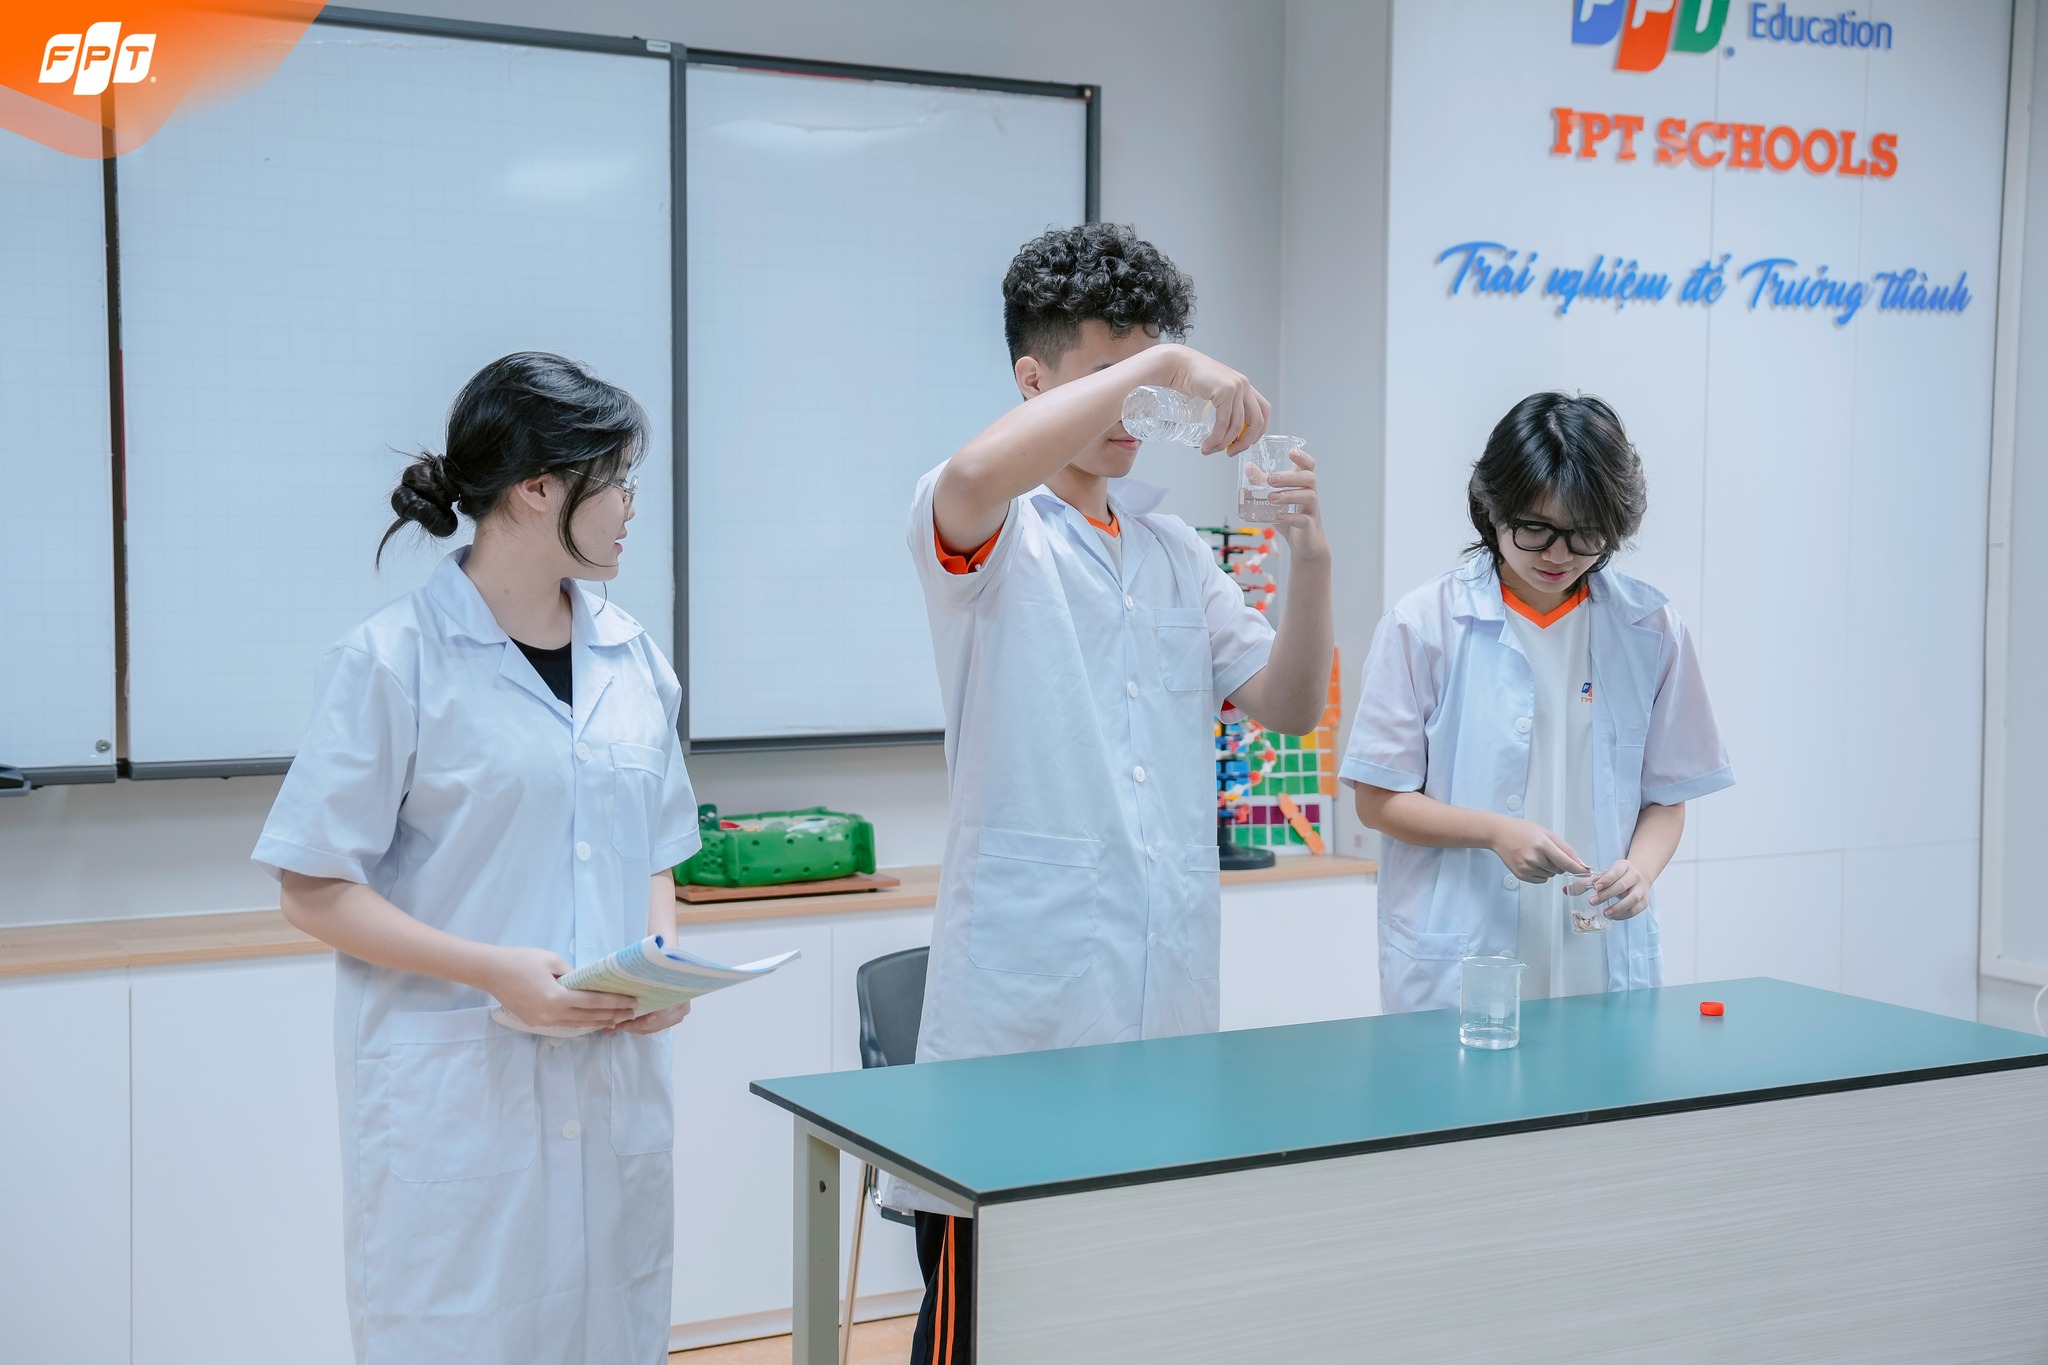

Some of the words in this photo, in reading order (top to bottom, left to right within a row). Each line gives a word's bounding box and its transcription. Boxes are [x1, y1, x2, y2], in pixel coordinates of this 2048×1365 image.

[1751, 3, 1892, 49] Education
[1656, 117, 1898, 178] SCHOOLS
[1438, 241, 1537, 295] Trải
[1545, 255, 1672, 314] nghiệm
[1681, 254, 1732, 304] để
[1740, 258, 1863, 325] Trưởng
[1875, 268, 1972, 313] thành
